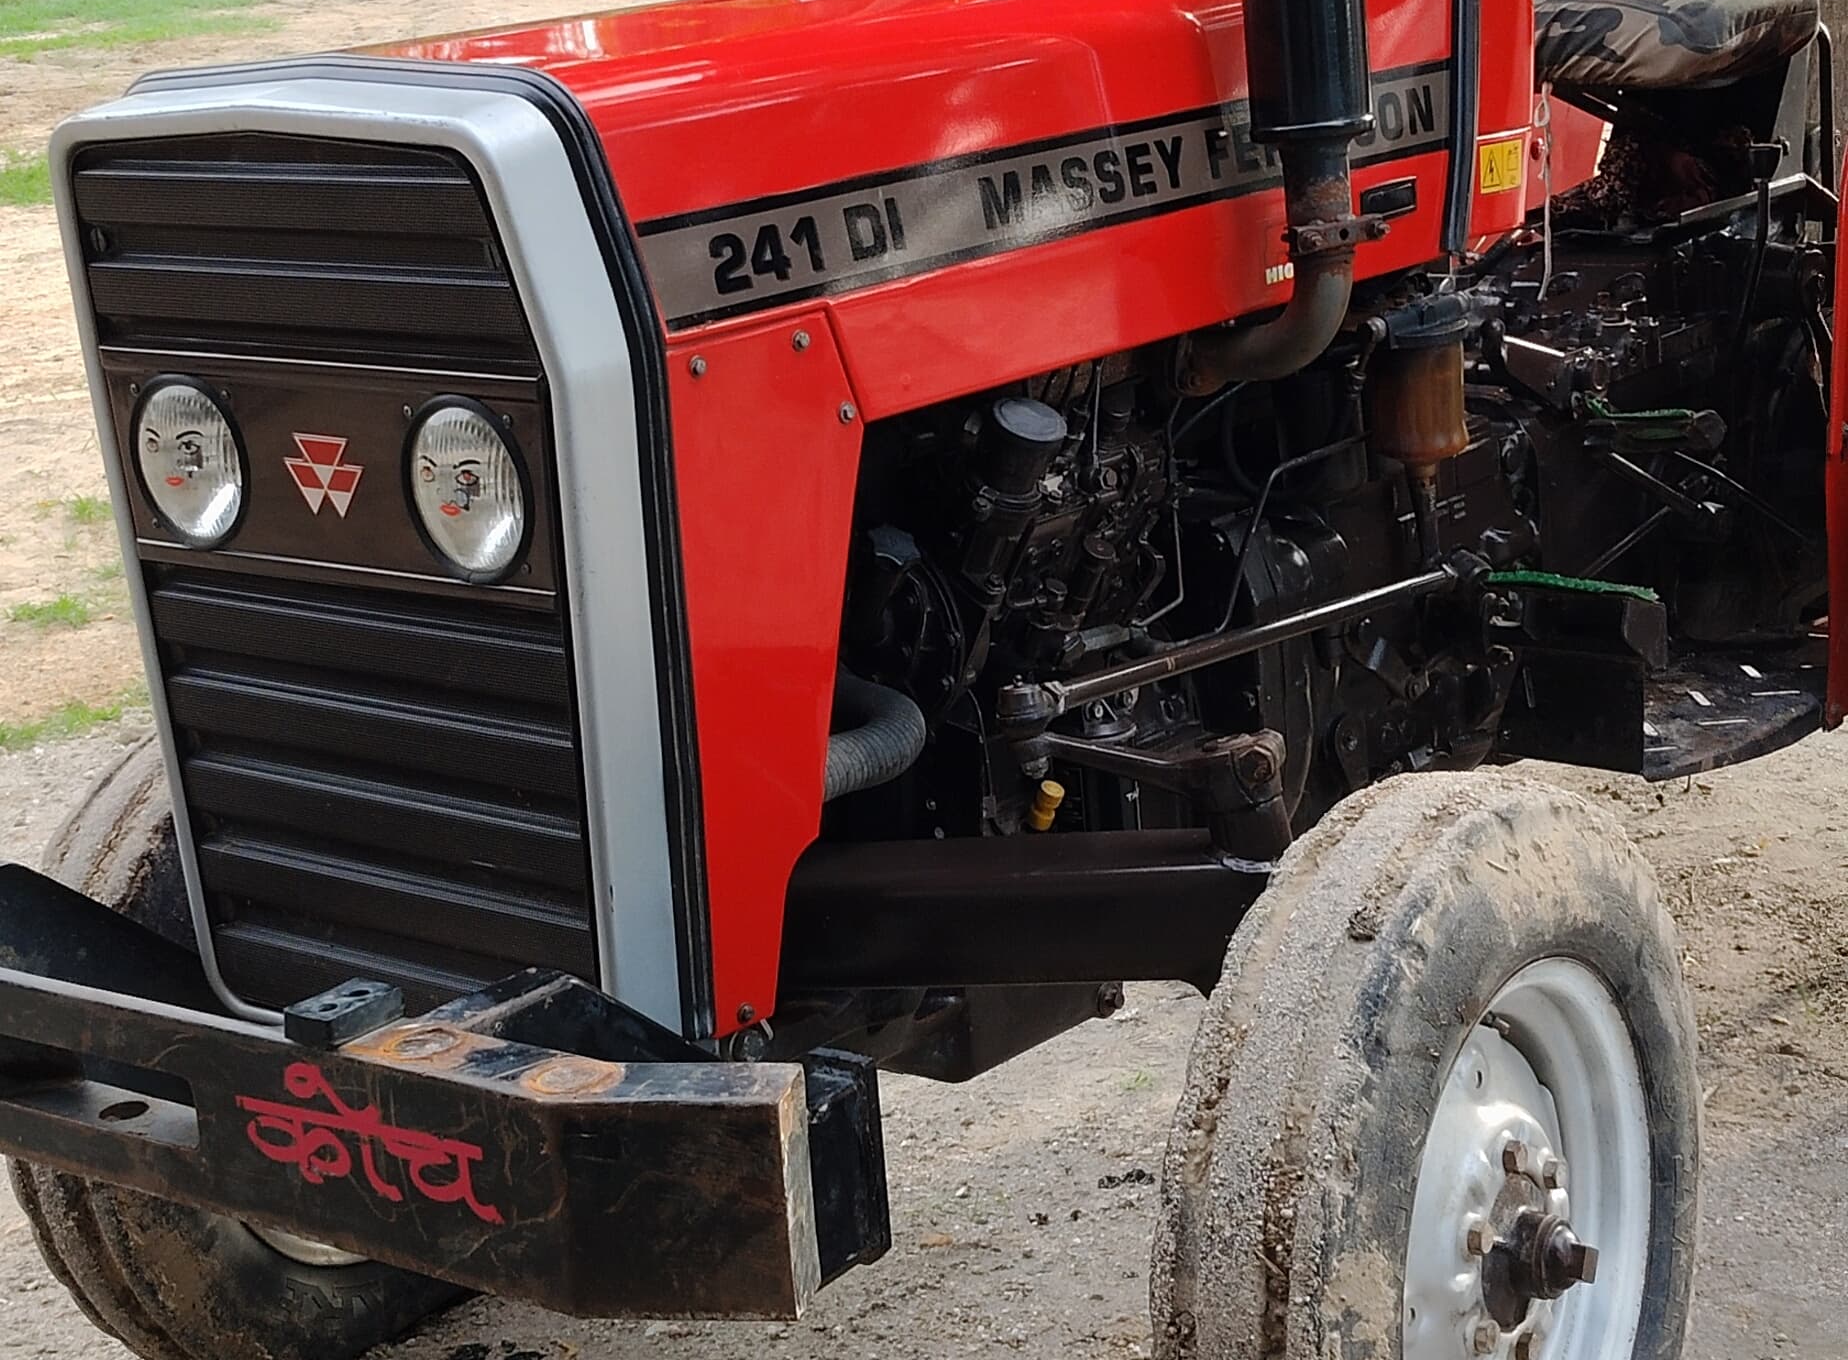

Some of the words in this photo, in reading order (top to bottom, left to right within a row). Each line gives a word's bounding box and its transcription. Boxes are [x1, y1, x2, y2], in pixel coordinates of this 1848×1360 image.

[708, 214, 826, 296] 241
[842, 196, 906, 263] DI
[977, 134, 1184, 231] MASSEY
